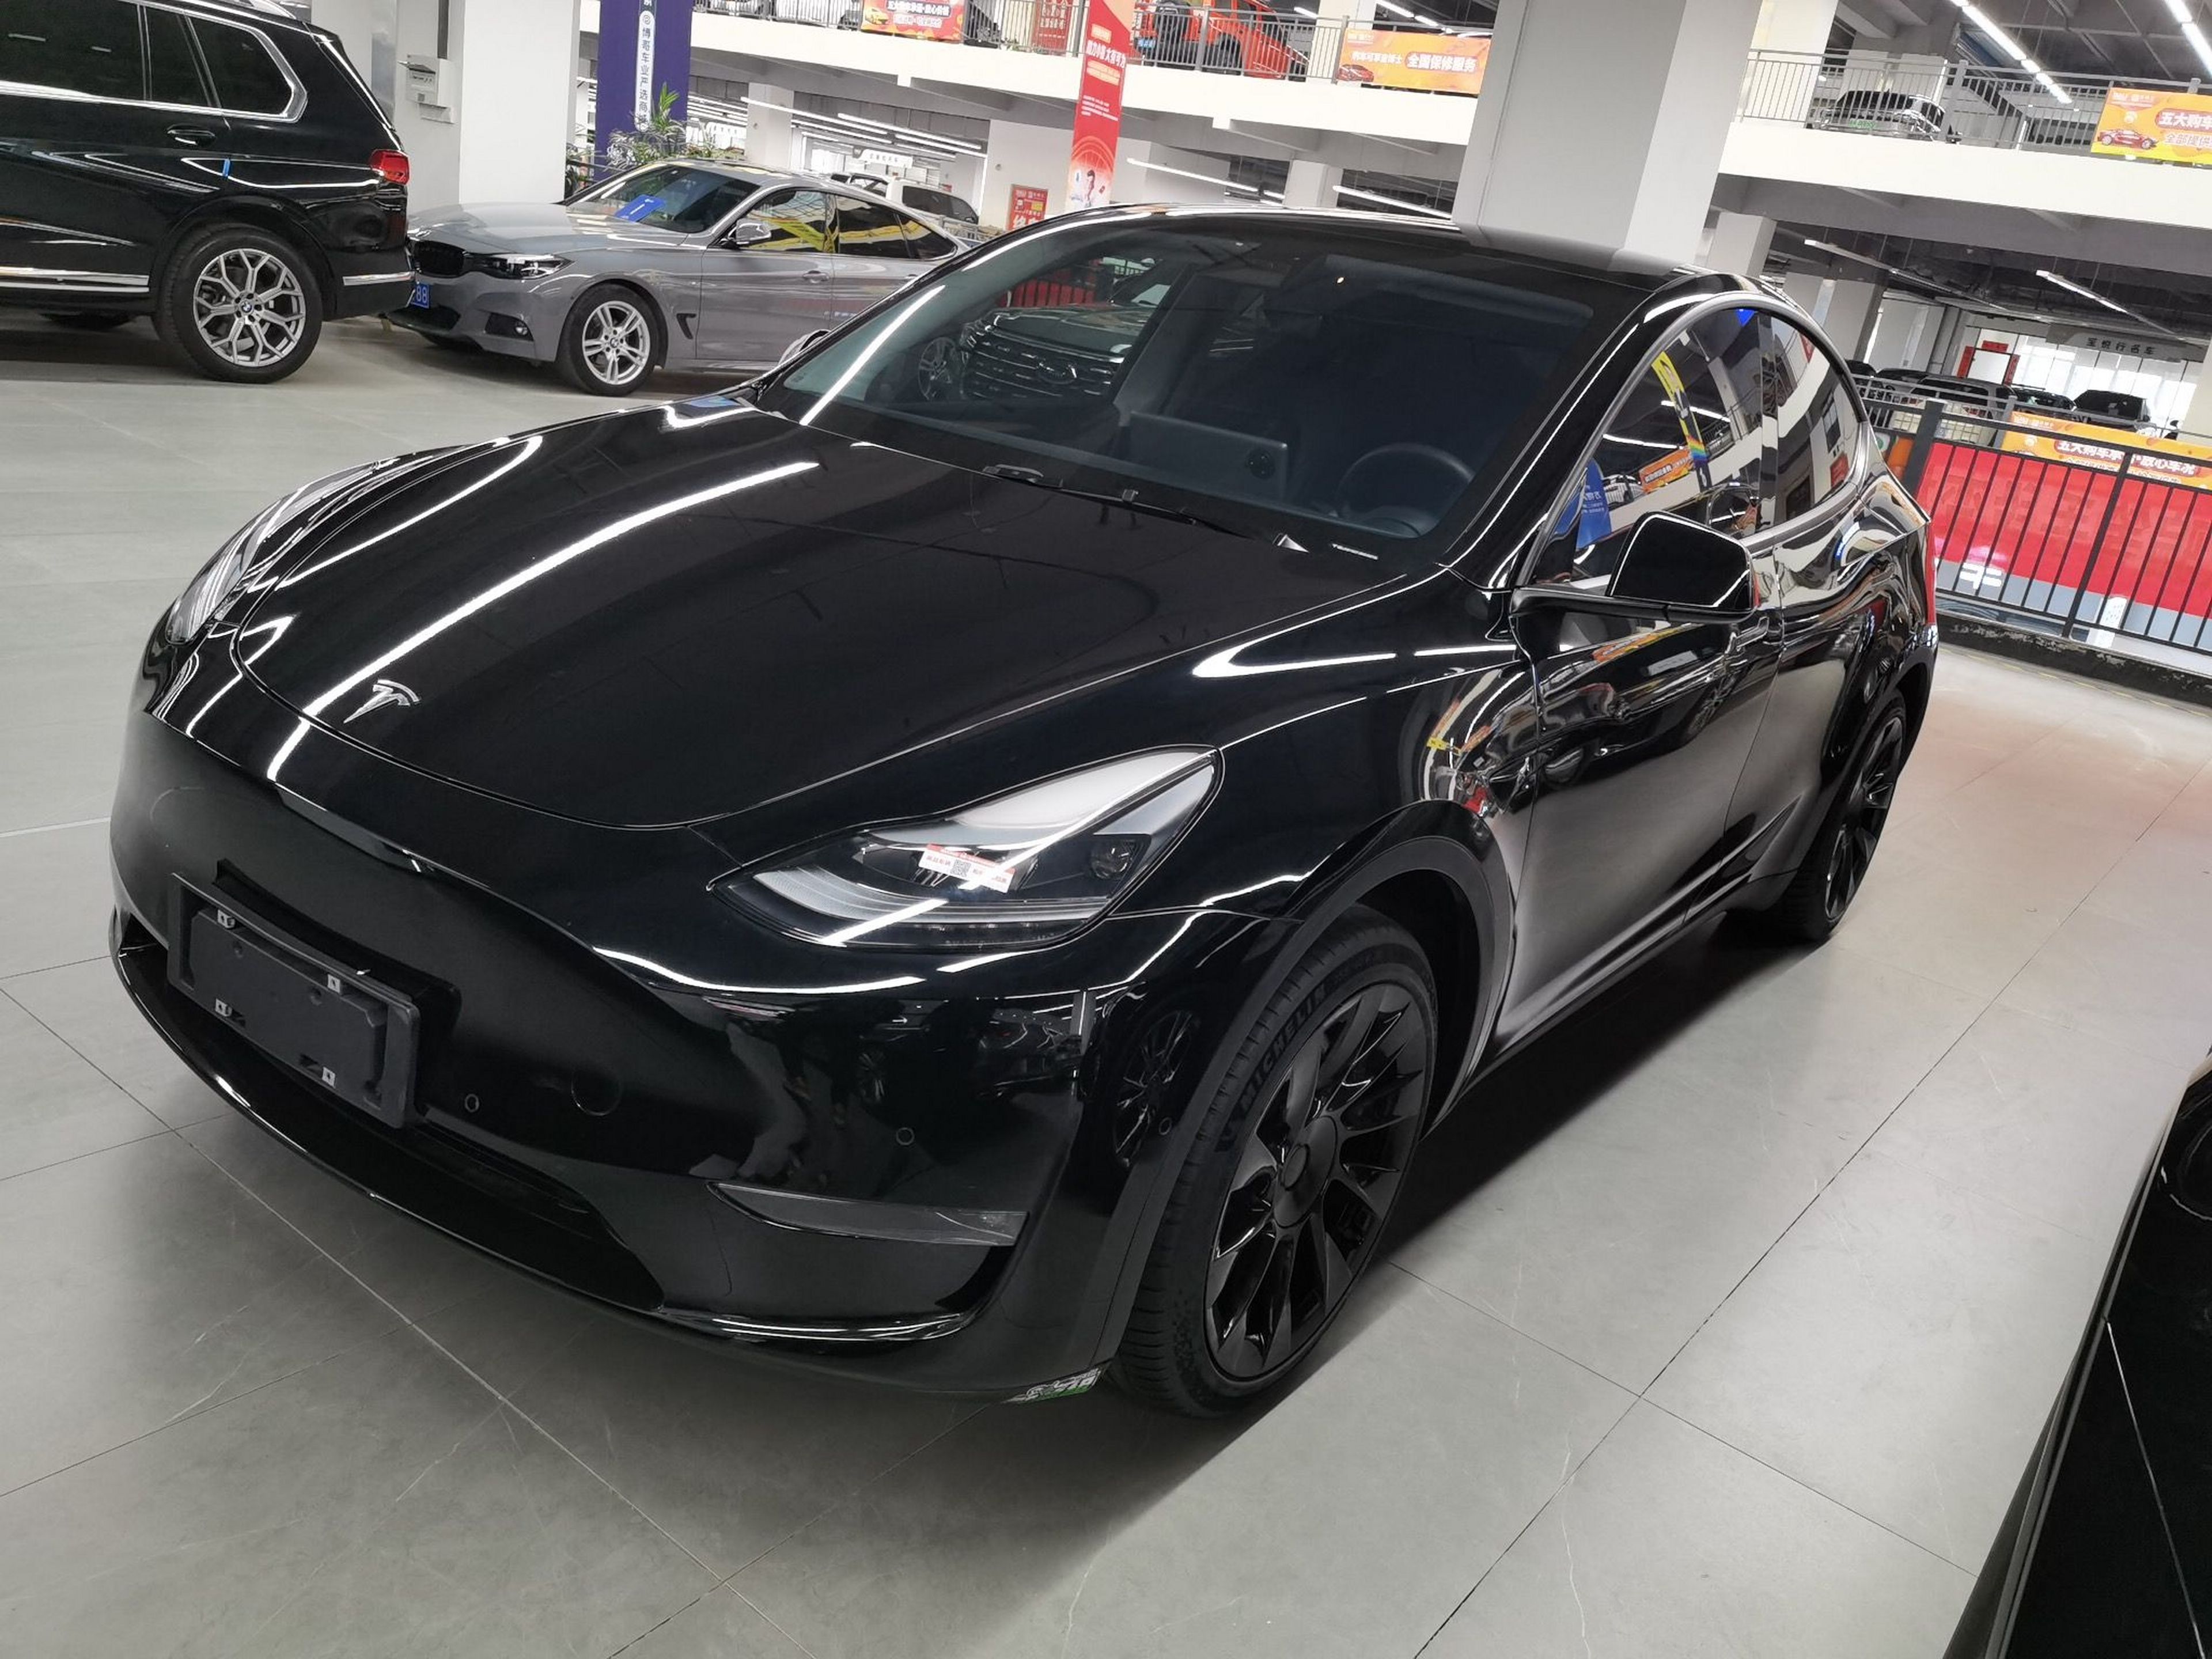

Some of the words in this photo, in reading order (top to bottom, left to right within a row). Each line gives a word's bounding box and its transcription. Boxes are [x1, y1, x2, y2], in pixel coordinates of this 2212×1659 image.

[1407, 52, 1477, 73] 全国保修服务
[1242, 982, 1327, 1109] MICHELIN
